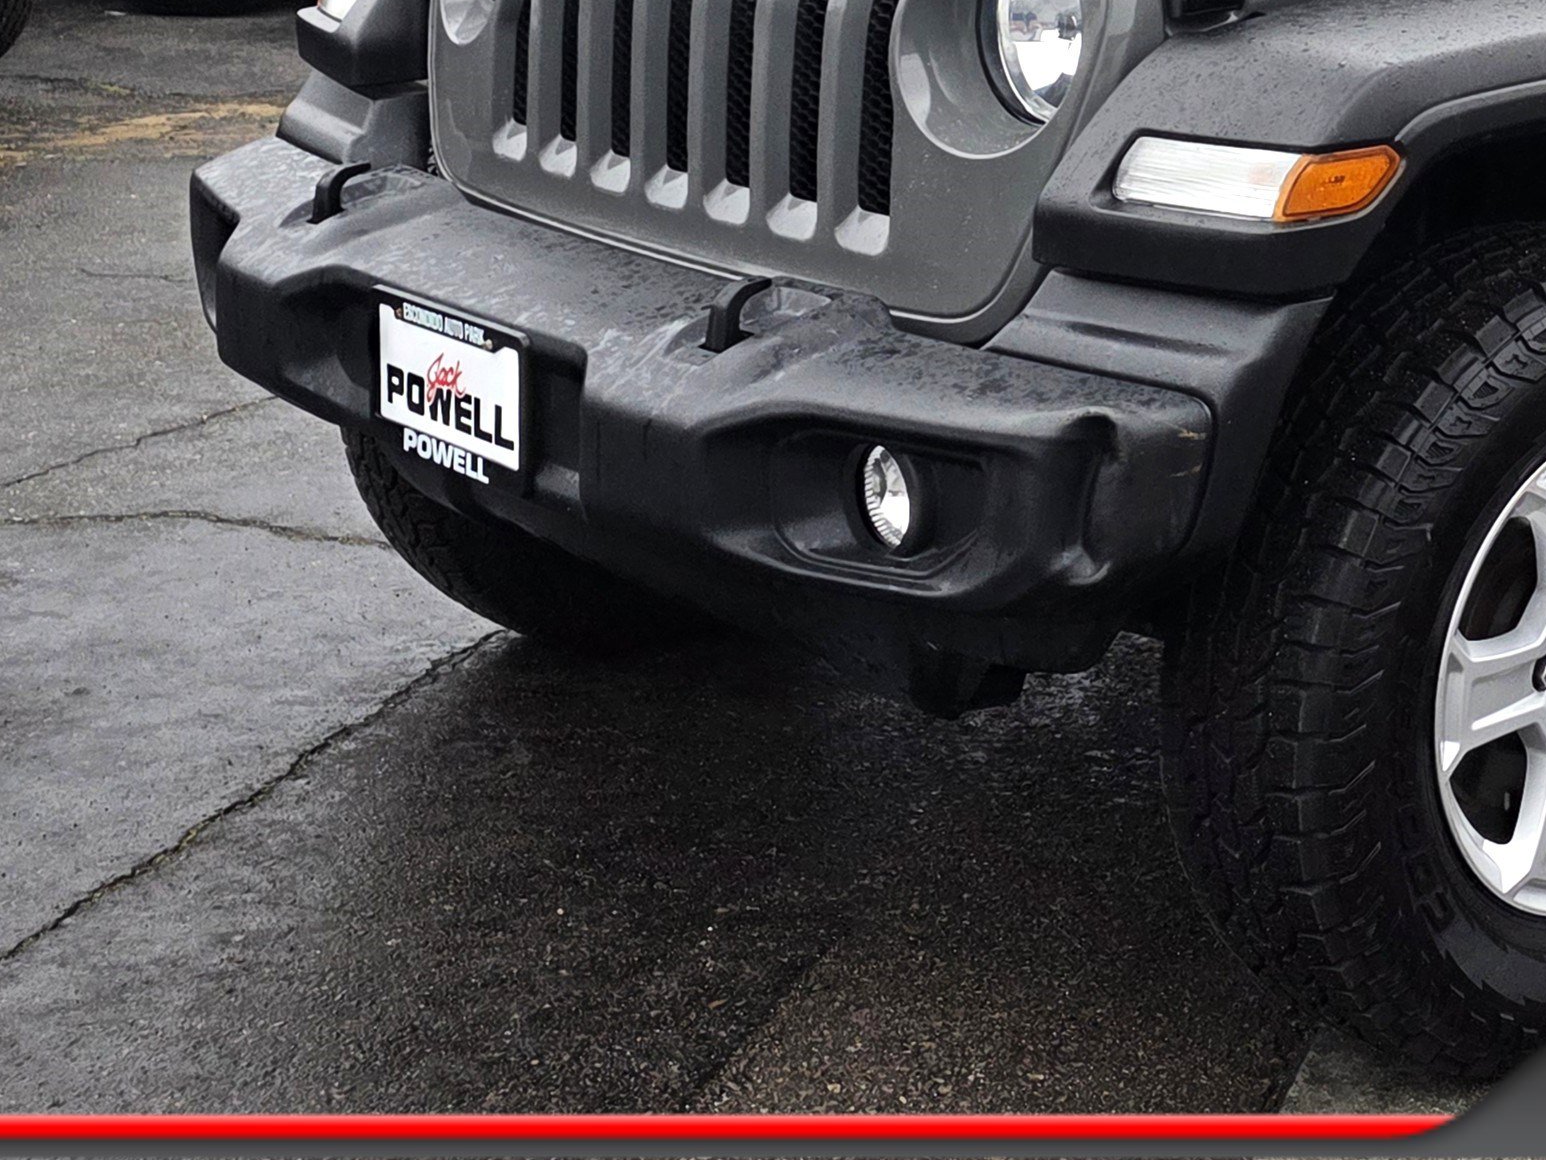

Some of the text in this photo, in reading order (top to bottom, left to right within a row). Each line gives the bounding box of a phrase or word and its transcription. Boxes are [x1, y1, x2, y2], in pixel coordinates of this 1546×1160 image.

[386, 362, 515, 452] POWELL
[427, 352, 466, 403] Jack
[402, 426, 490, 485] POWELL
